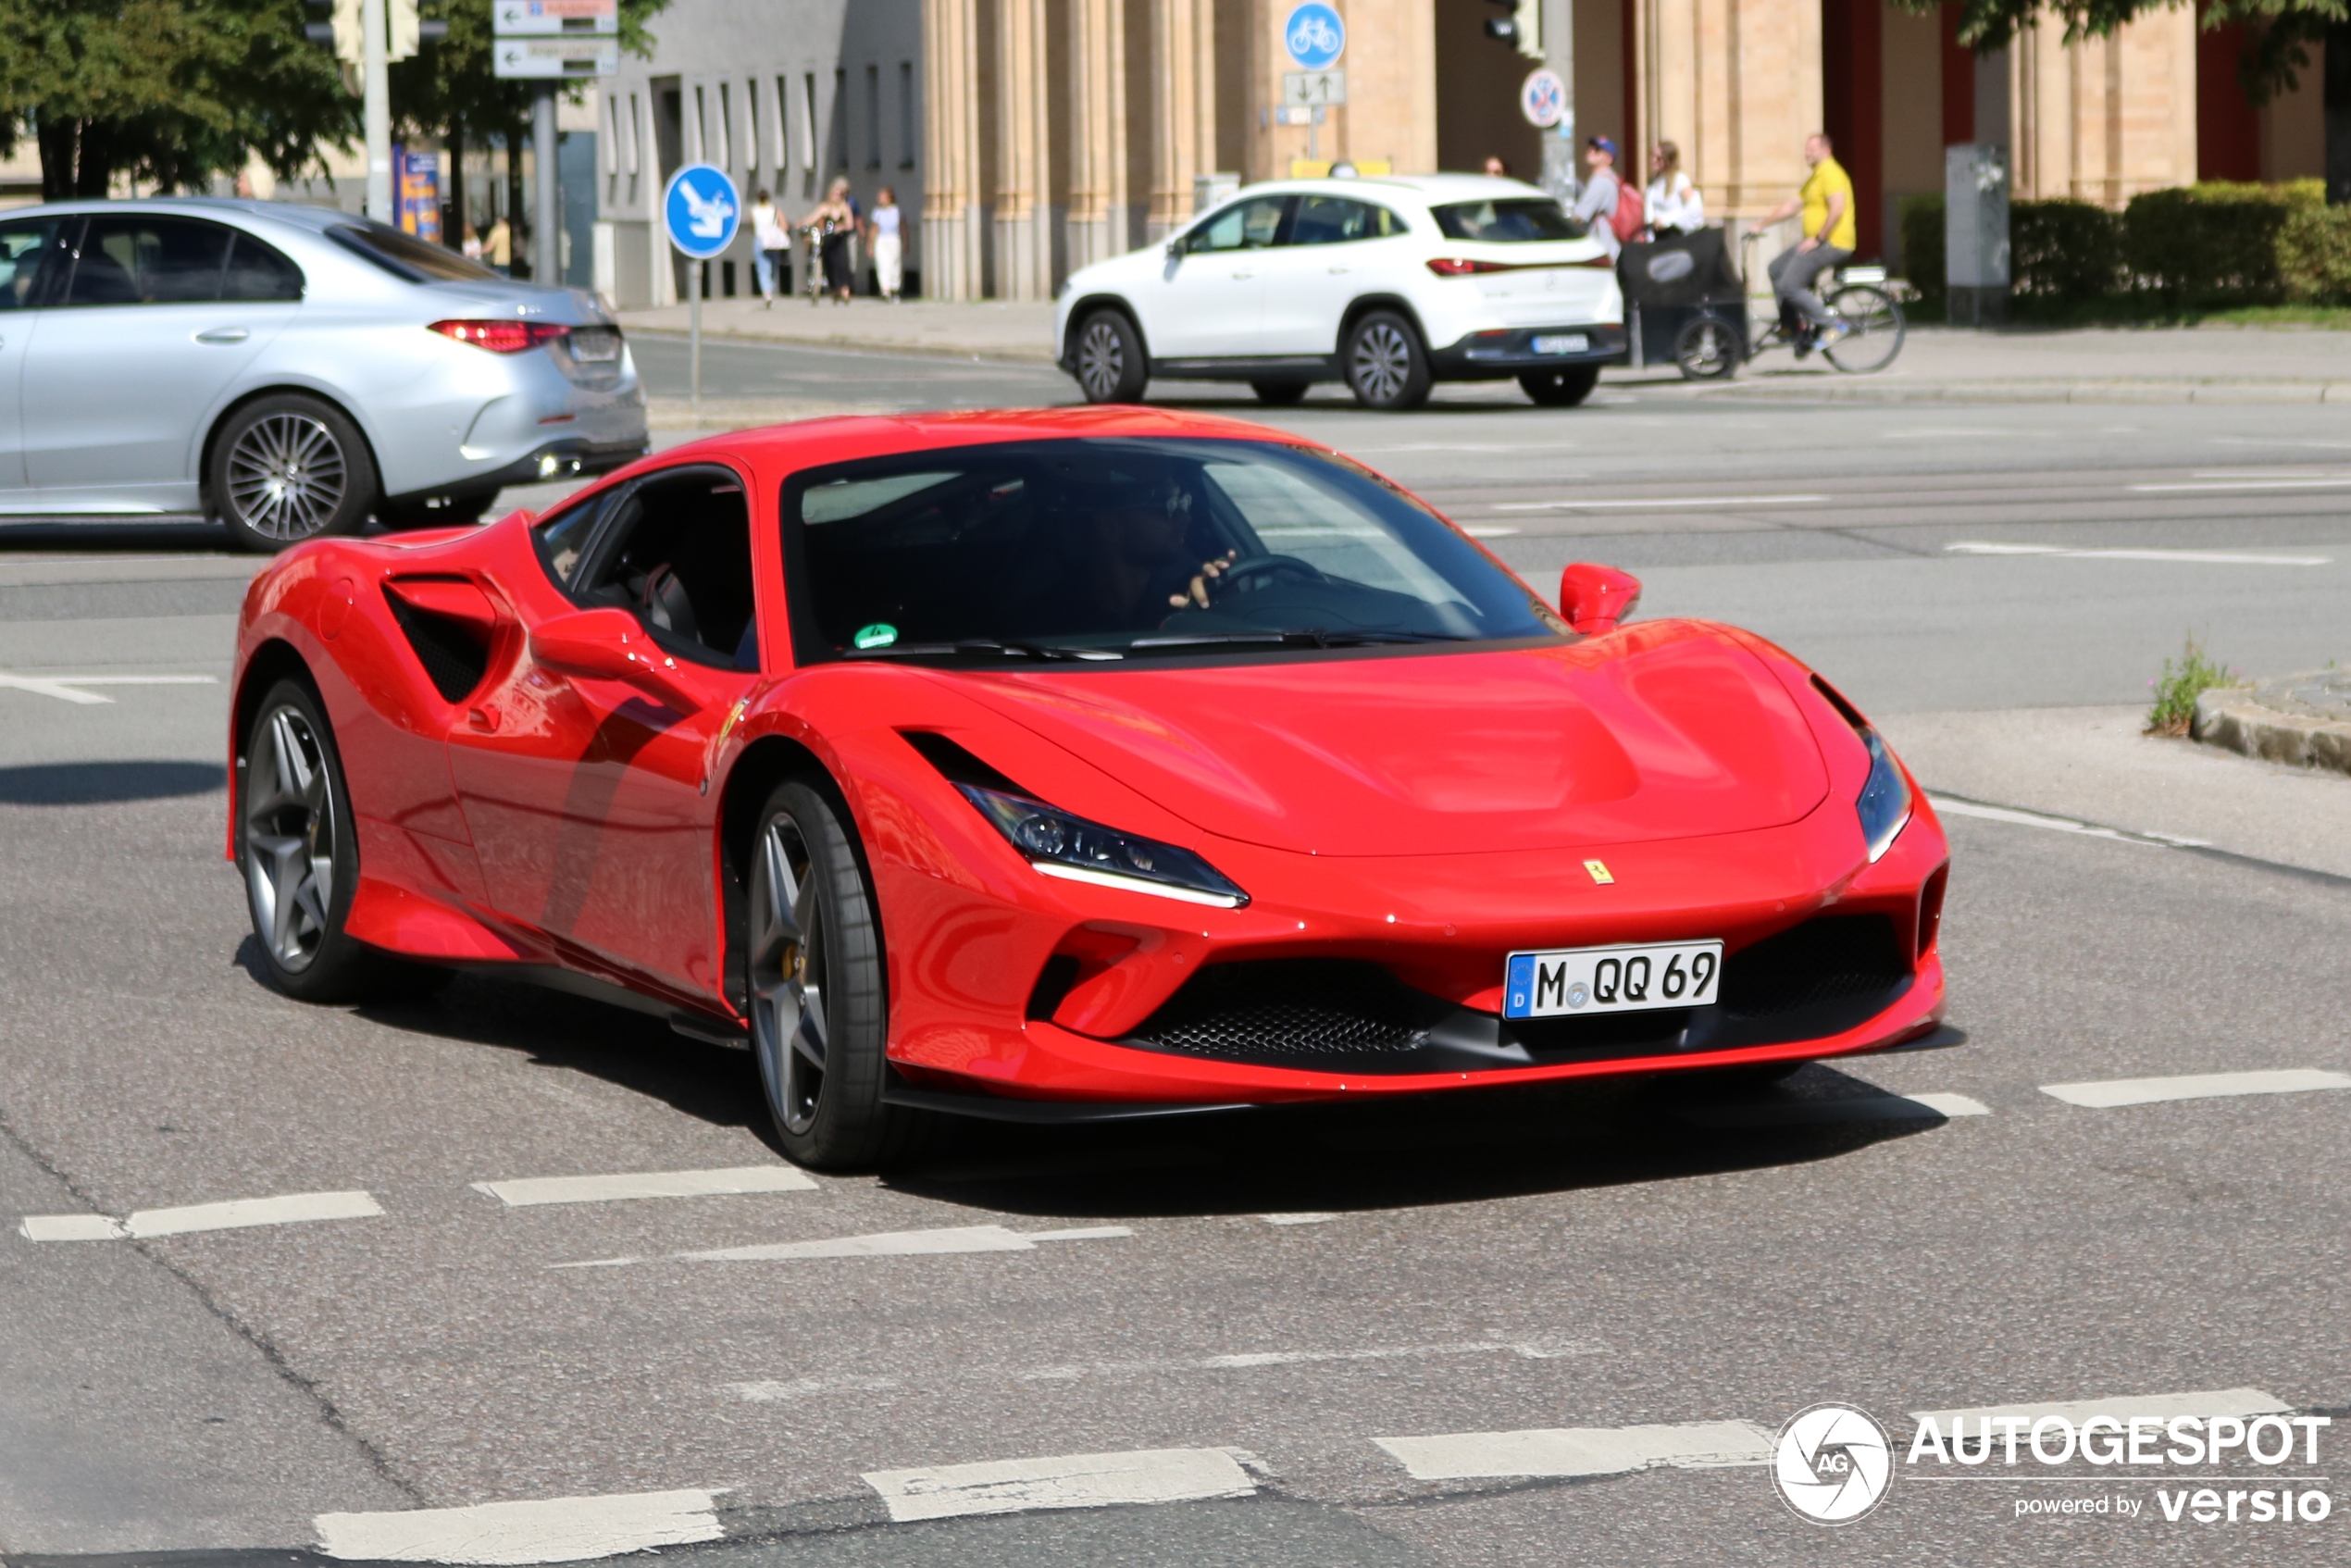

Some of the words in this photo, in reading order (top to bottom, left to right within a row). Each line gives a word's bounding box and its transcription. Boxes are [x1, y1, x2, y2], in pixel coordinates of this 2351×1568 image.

[1536, 962, 1567, 1009] M
[1593, 956, 1652, 1005] QQ
[1662, 952, 1717, 1000] 69
[1514, 993, 1525, 1008] D
